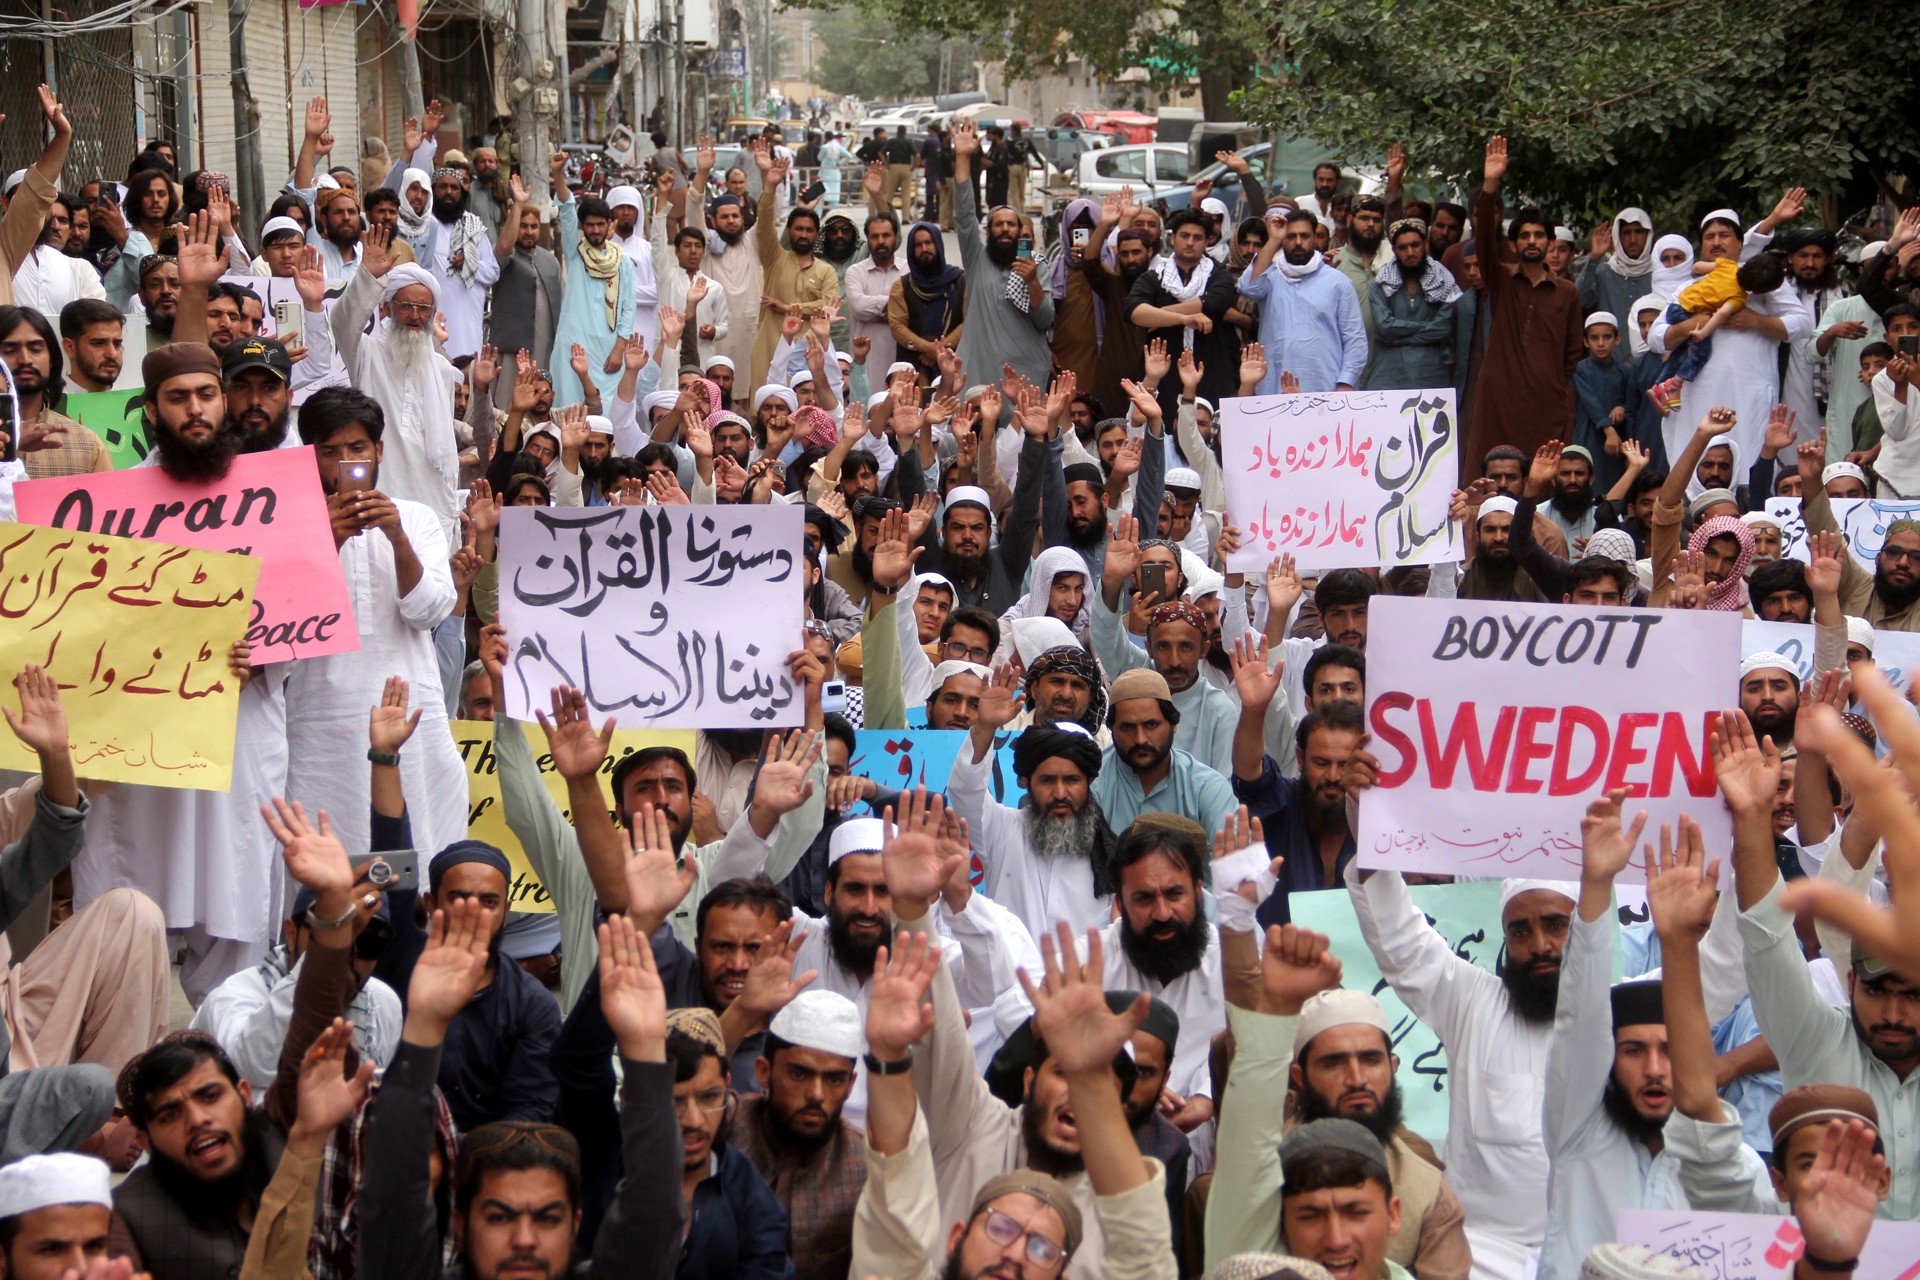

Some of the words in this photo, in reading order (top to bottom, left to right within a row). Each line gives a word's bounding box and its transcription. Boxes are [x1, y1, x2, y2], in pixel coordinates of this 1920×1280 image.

[1246, 427, 1282, 479] باد
[1285, 434, 1329, 473] زندہ
[1331, 417, 1373, 477] ہمارا
[1375, 390, 1451, 495] قرآن
[684, 512, 793, 586] دستورنا
[1242, 499, 1277, 551] باد
[1280, 507, 1320, 548] زندہ
[1316, 499, 1367, 548] ہمارا
[1375, 491, 1454, 562] اسلام
[0, 536, 110, 632] قرآن
[108, 546, 191, 606] گئے
[172, 562, 244, 608] مٹ
[513, 507, 672, 617] القرآن
[633, 600, 669, 636] و
[1432, 615, 1663, 669] BOYCOTT
[122, 640, 225, 700] مٹانے
[513, 630, 707, 718] الاسلام
[1369, 691, 1722, 798] SWEDEN
